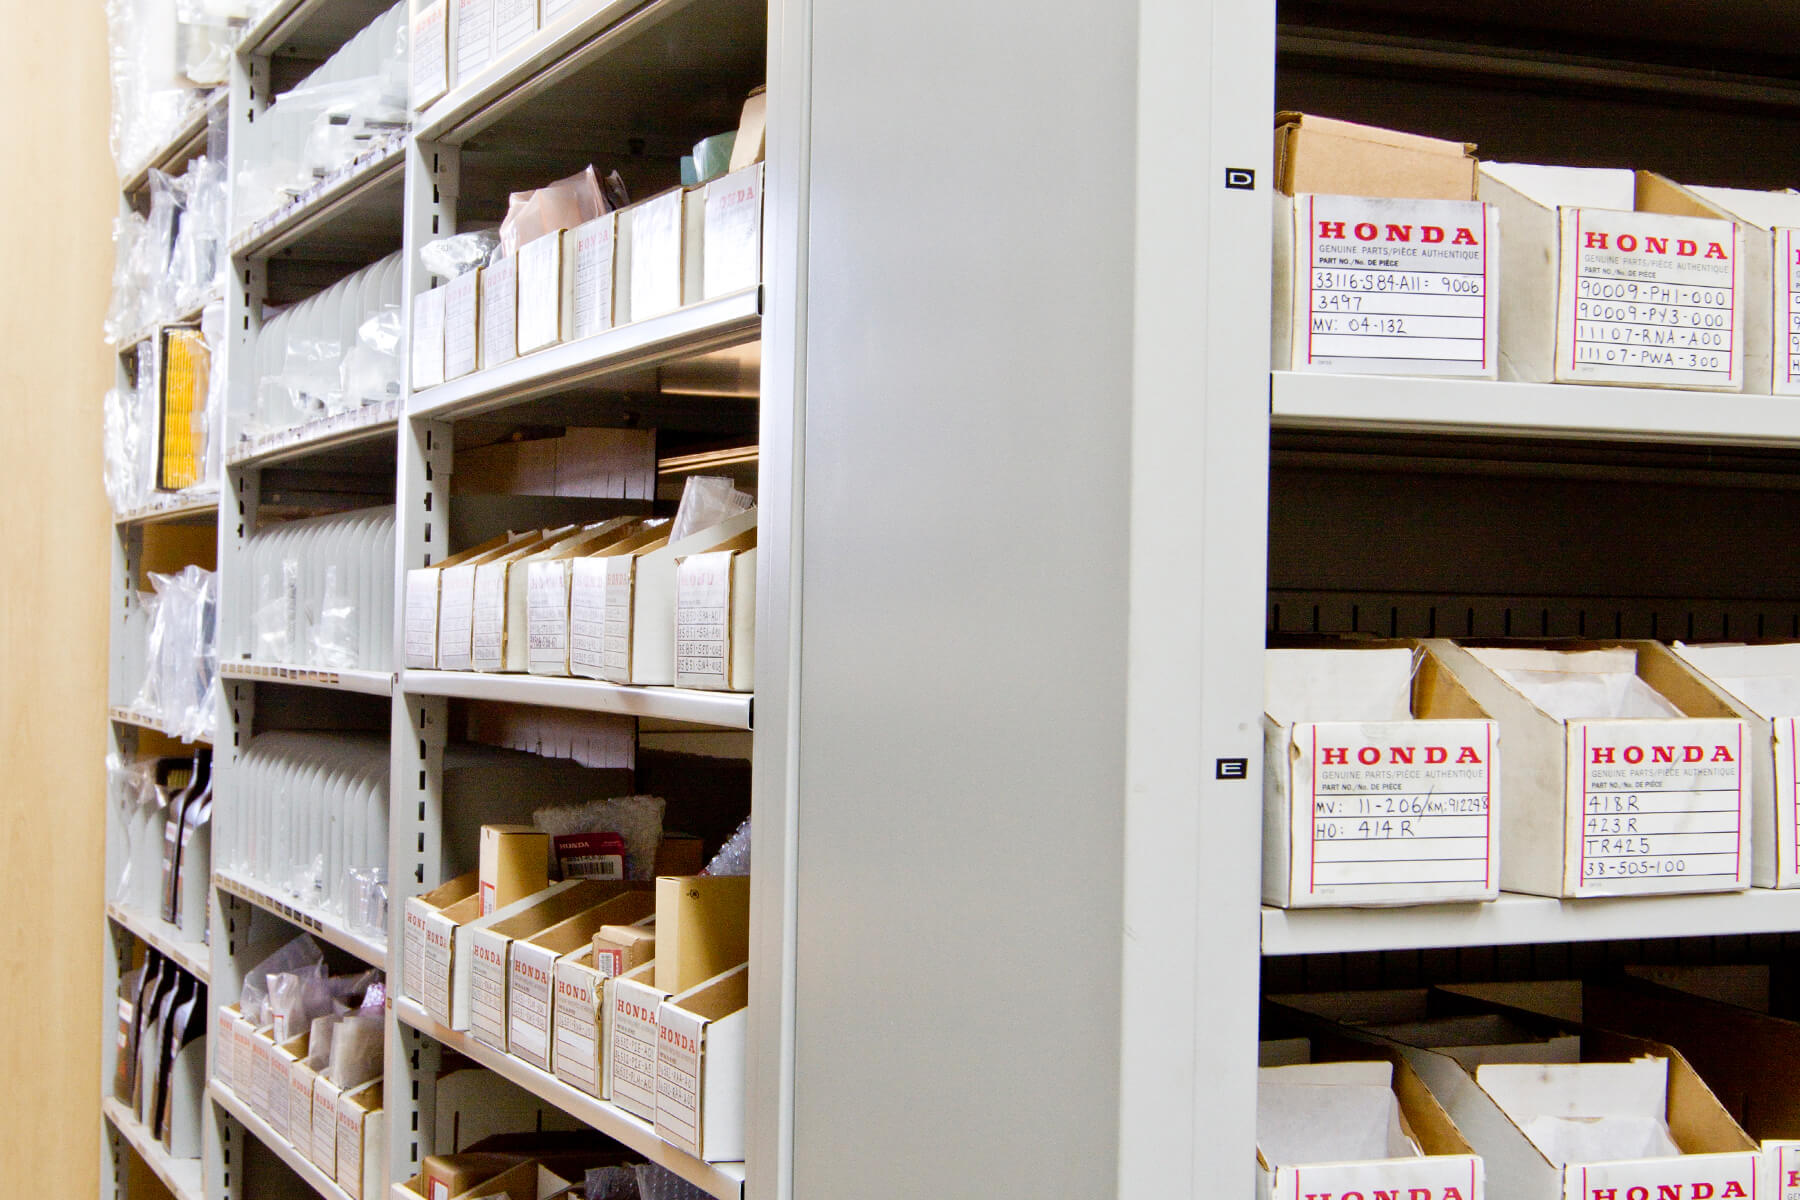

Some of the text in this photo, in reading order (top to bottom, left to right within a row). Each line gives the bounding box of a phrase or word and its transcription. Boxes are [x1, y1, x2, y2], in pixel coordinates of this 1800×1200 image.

[1229, 172, 1252, 185] D
[1318, 221, 1479, 246] HONDA
[1319, 245, 1357, 254] GENUINE
[1421, 249, 1480, 261] AUTHENTIQUE
[1584, 232, 1728, 260] HONDA
[1319, 257, 1337, 265] PART
[1585, 254, 1620, 265] GENUINE
[1677, 262, 1729, 274] AUTHENTIQUE
[1442, 276, 1480, 294] 9006
[1581, 280, 1725, 306] 90009-PH1-000
[1580, 303, 1724, 327] 90009-PY3-000
[1312, 317, 1407, 335] MV: 04-132
[1580, 325, 1722, 346] 11107-RNA-A00
[1580, 347, 1719, 368] 11107-PWA-300
[1321, 746, 1482, 765] HONDA
[1591, 745, 1735, 765] HONDA
[1221, 763, 1242, 775] E
[1322, 770, 1361, 780] GENUINE
[1425, 769, 1484, 780] AUTHENTIQUE
[1591, 769, 1626, 778] GENUINE
[1683, 767, 1736, 777] AUTHENTIQUE
[1371, 783, 1380, 791] DE
[1316, 801, 1343, 814] MV:
[1585, 859, 1686, 876] 38-505-100
[474, 944, 502, 966] HONDA
[514, 959, 547, 985] HONDA
[617, 999, 656, 1025] HONDA
[659, 1025, 696, 1054] HONDA
[1592, 1181, 1748, 1200] HONDA
